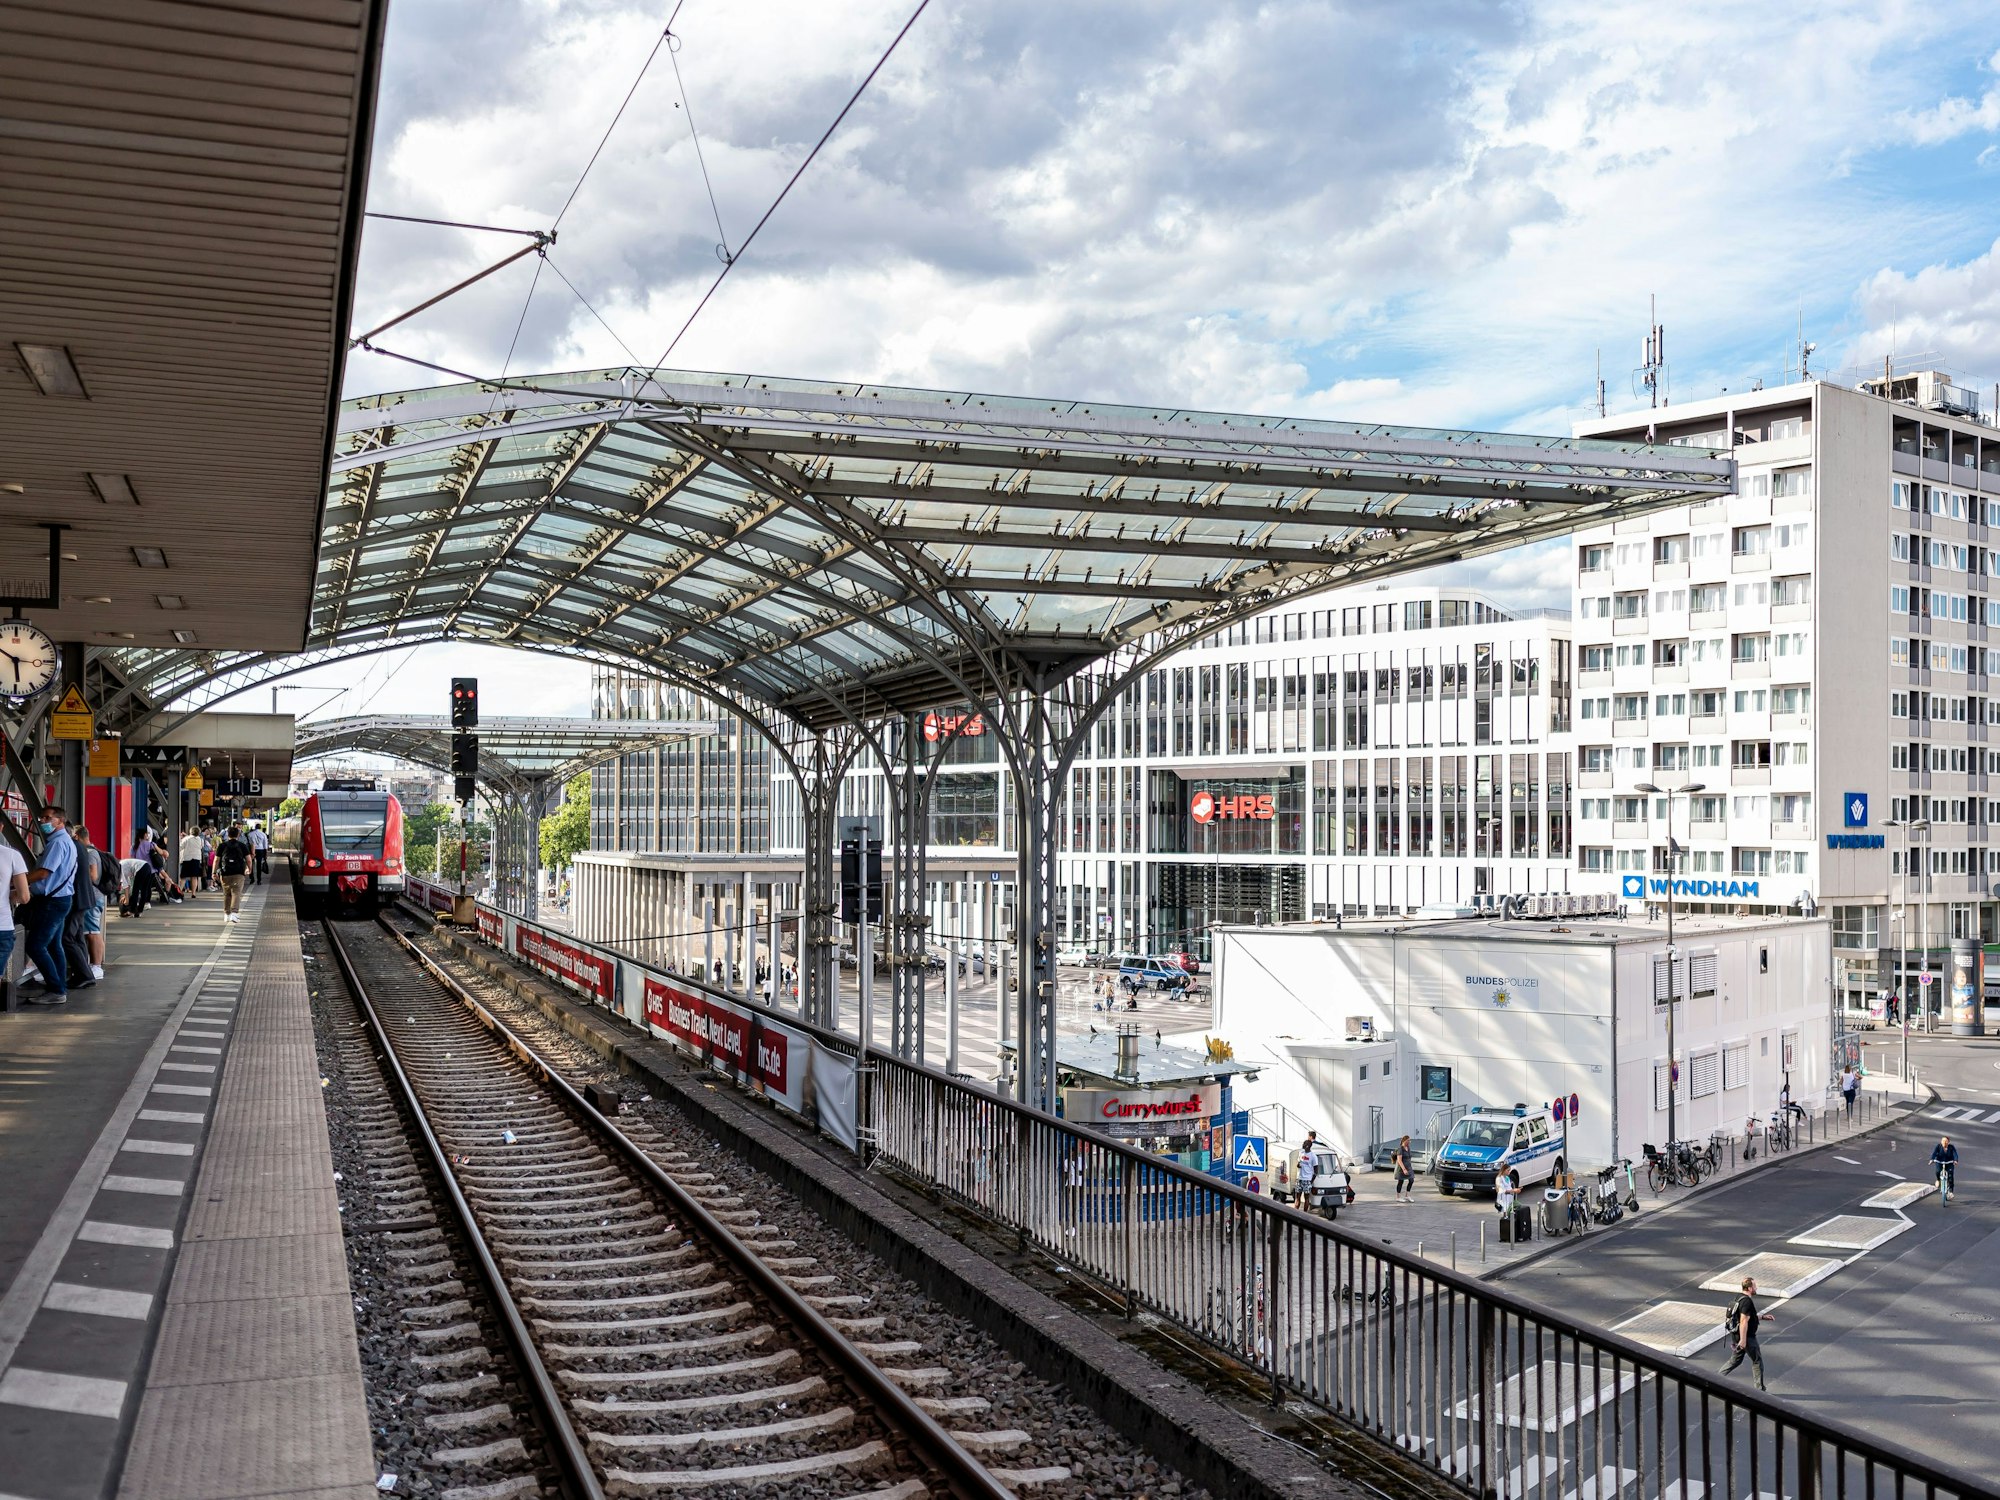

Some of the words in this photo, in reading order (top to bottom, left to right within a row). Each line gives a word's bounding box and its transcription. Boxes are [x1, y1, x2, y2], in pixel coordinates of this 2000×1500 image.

[227, 779, 240, 793] 11
[249, 779, 261, 793] B
[1219, 794, 1275, 820] HRS
[348, 862, 360, 870] DB
[991, 872, 999, 880] U
[1650, 878, 1760, 898] WYNDHAM
[1465, 976, 1539, 988] BUNDESPOLIZEI
[652, 993, 663, 1016] HRS
[668, 1000, 690, 1031] Business
[690, 1008, 708, 1040] Travel.
[709, 1017, 724, 1048] Next
[724, 1023, 743, 1057] Level.
[757, 1038, 781, 1078] hrs.de
[1103, 1095, 1202, 1119] Currywurst
[1452, 1149, 1483, 1158] POLIZEI
